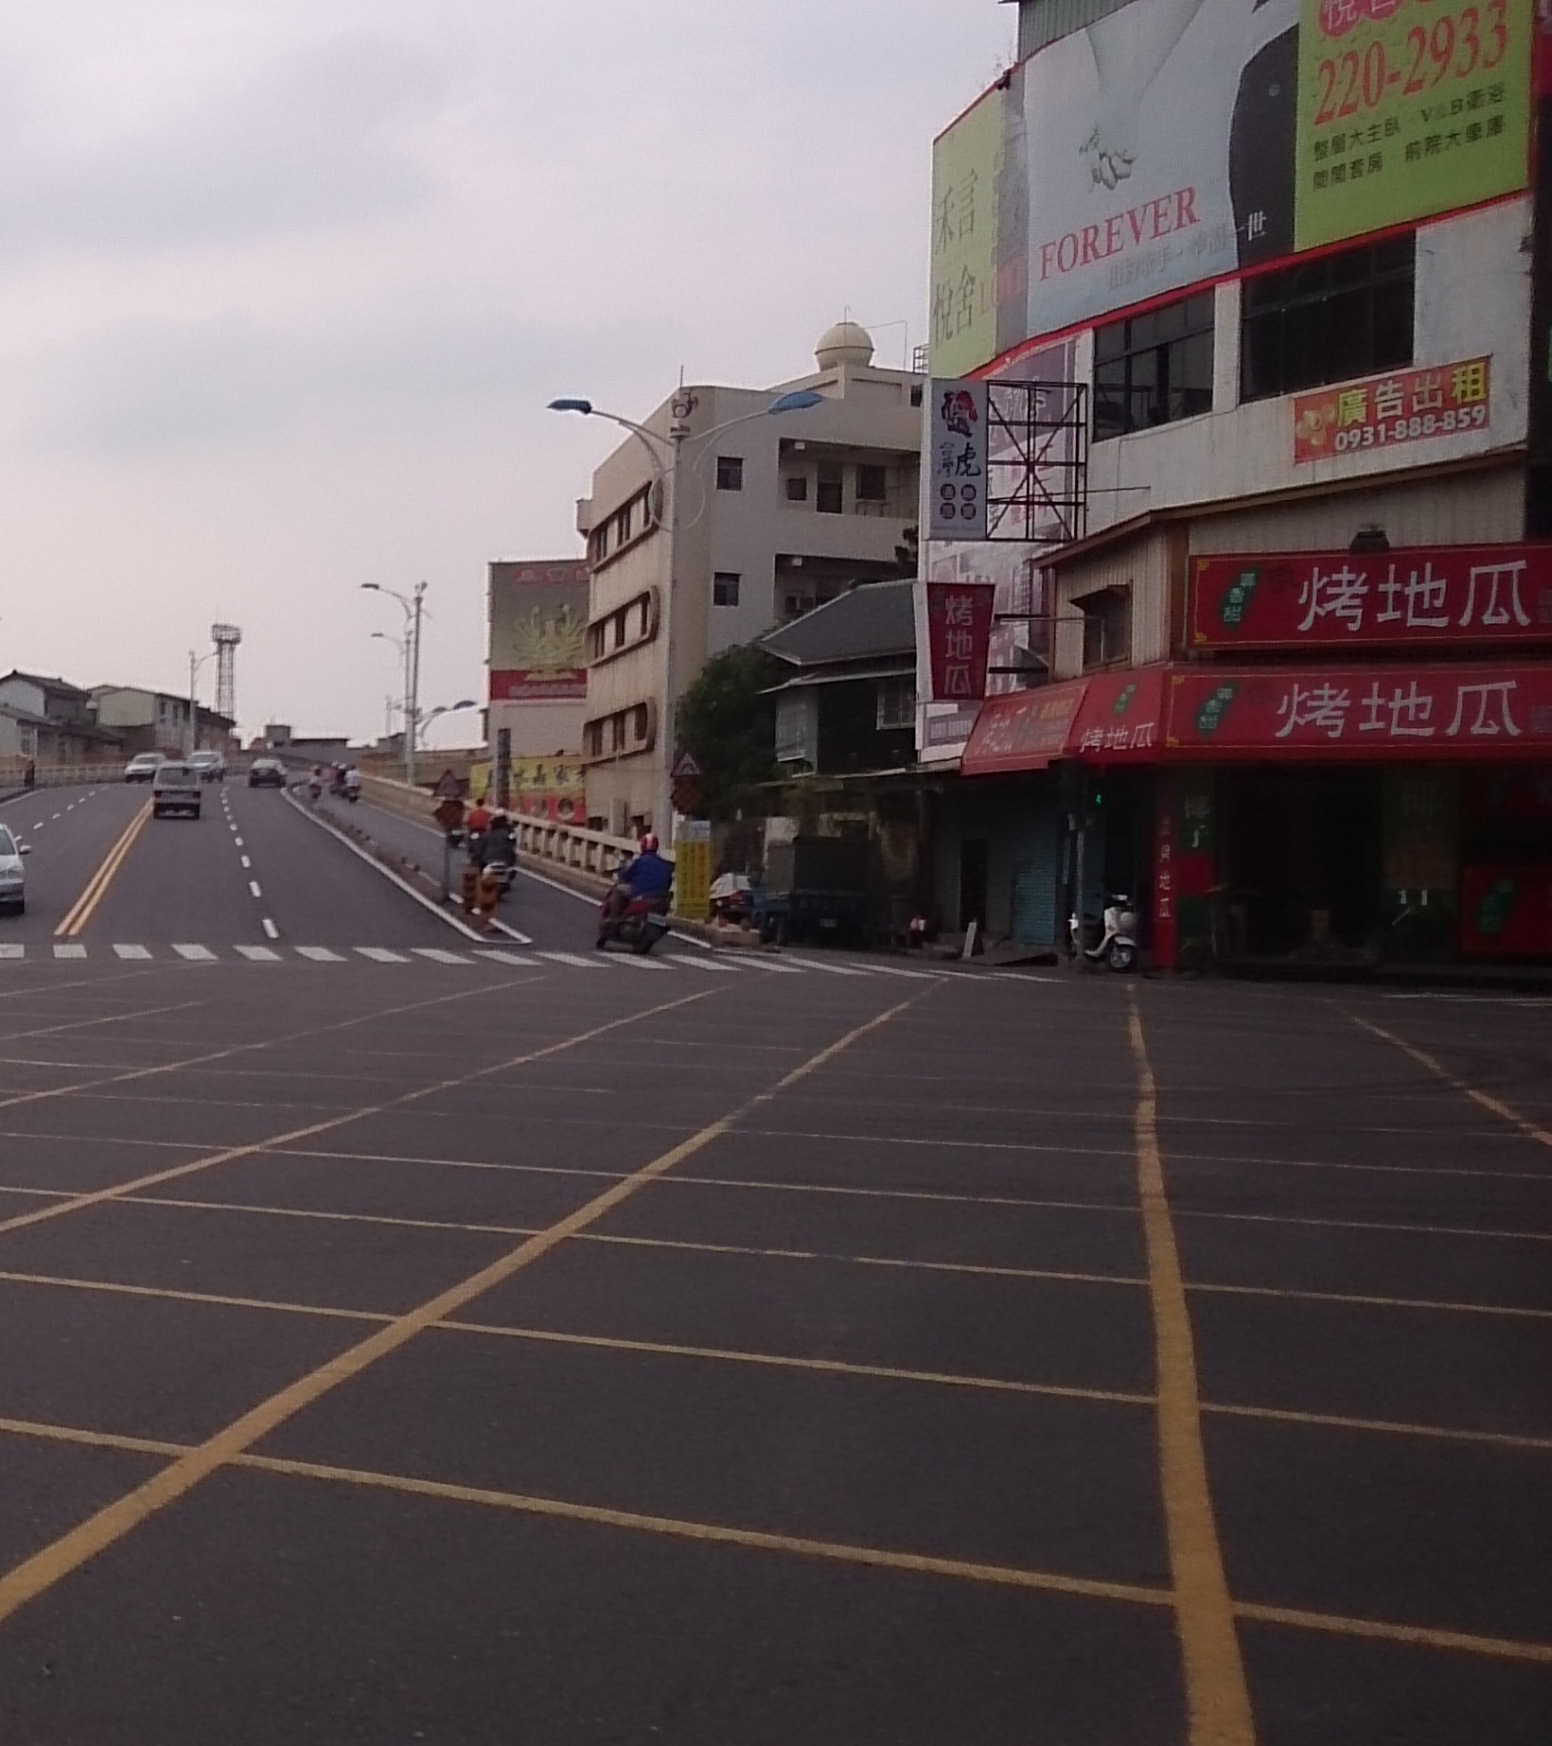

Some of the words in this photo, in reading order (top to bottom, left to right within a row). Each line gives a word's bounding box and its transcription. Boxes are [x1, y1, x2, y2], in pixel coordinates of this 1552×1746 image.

[1315, 0, 1507, 125] 220-2933
[1039, 186, 1200, 282] FOREVER
[1334, 405, 1487, 452] 0931-888-859
[1335, 361, 1487, 427] 廣告出租
[1298, 559, 1531, 632] 烤地瓜
[943, 595, 974, 695] 烤地瓜
[1079, 722, 1155, 753] 烤地瓜
[1275, 680, 1521, 738] 烤地瓜
